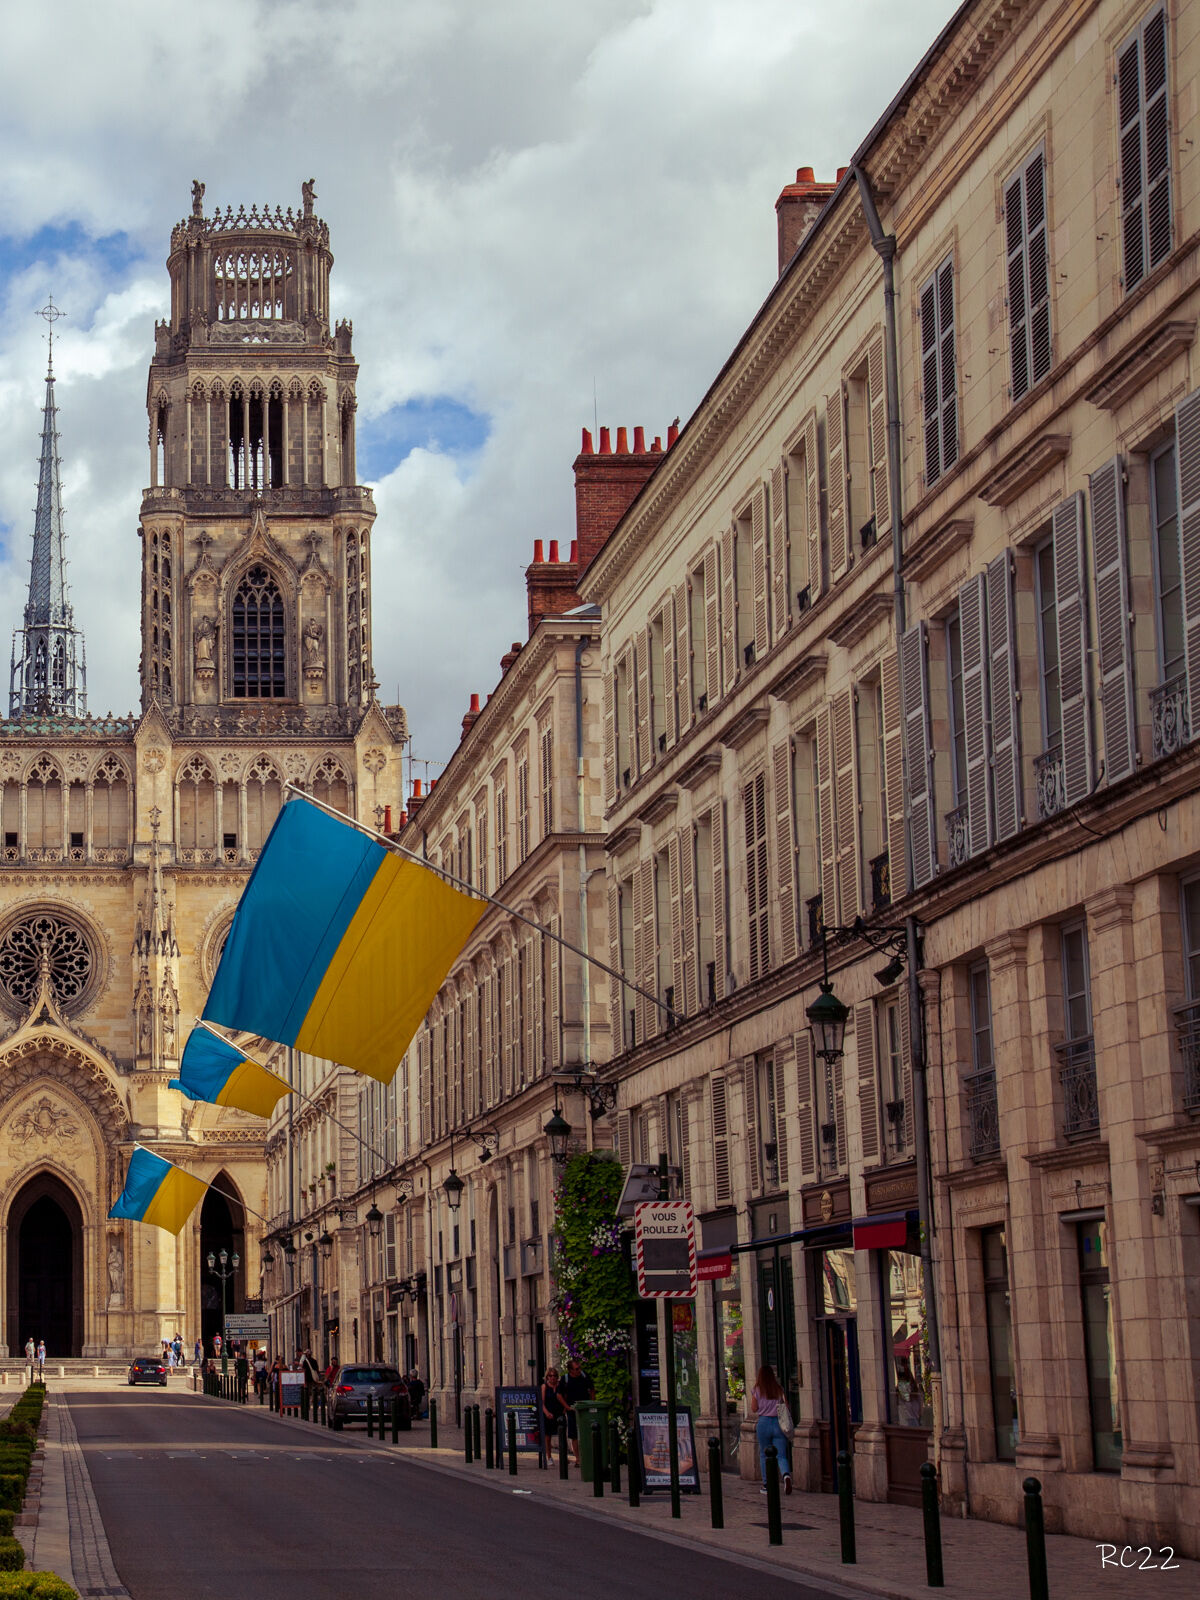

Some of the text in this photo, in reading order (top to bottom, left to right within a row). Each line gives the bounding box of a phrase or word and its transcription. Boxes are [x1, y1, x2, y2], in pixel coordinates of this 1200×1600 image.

[652, 1213, 677, 1221] VOUS
[643, 1224, 687, 1234] ROULEZ À
